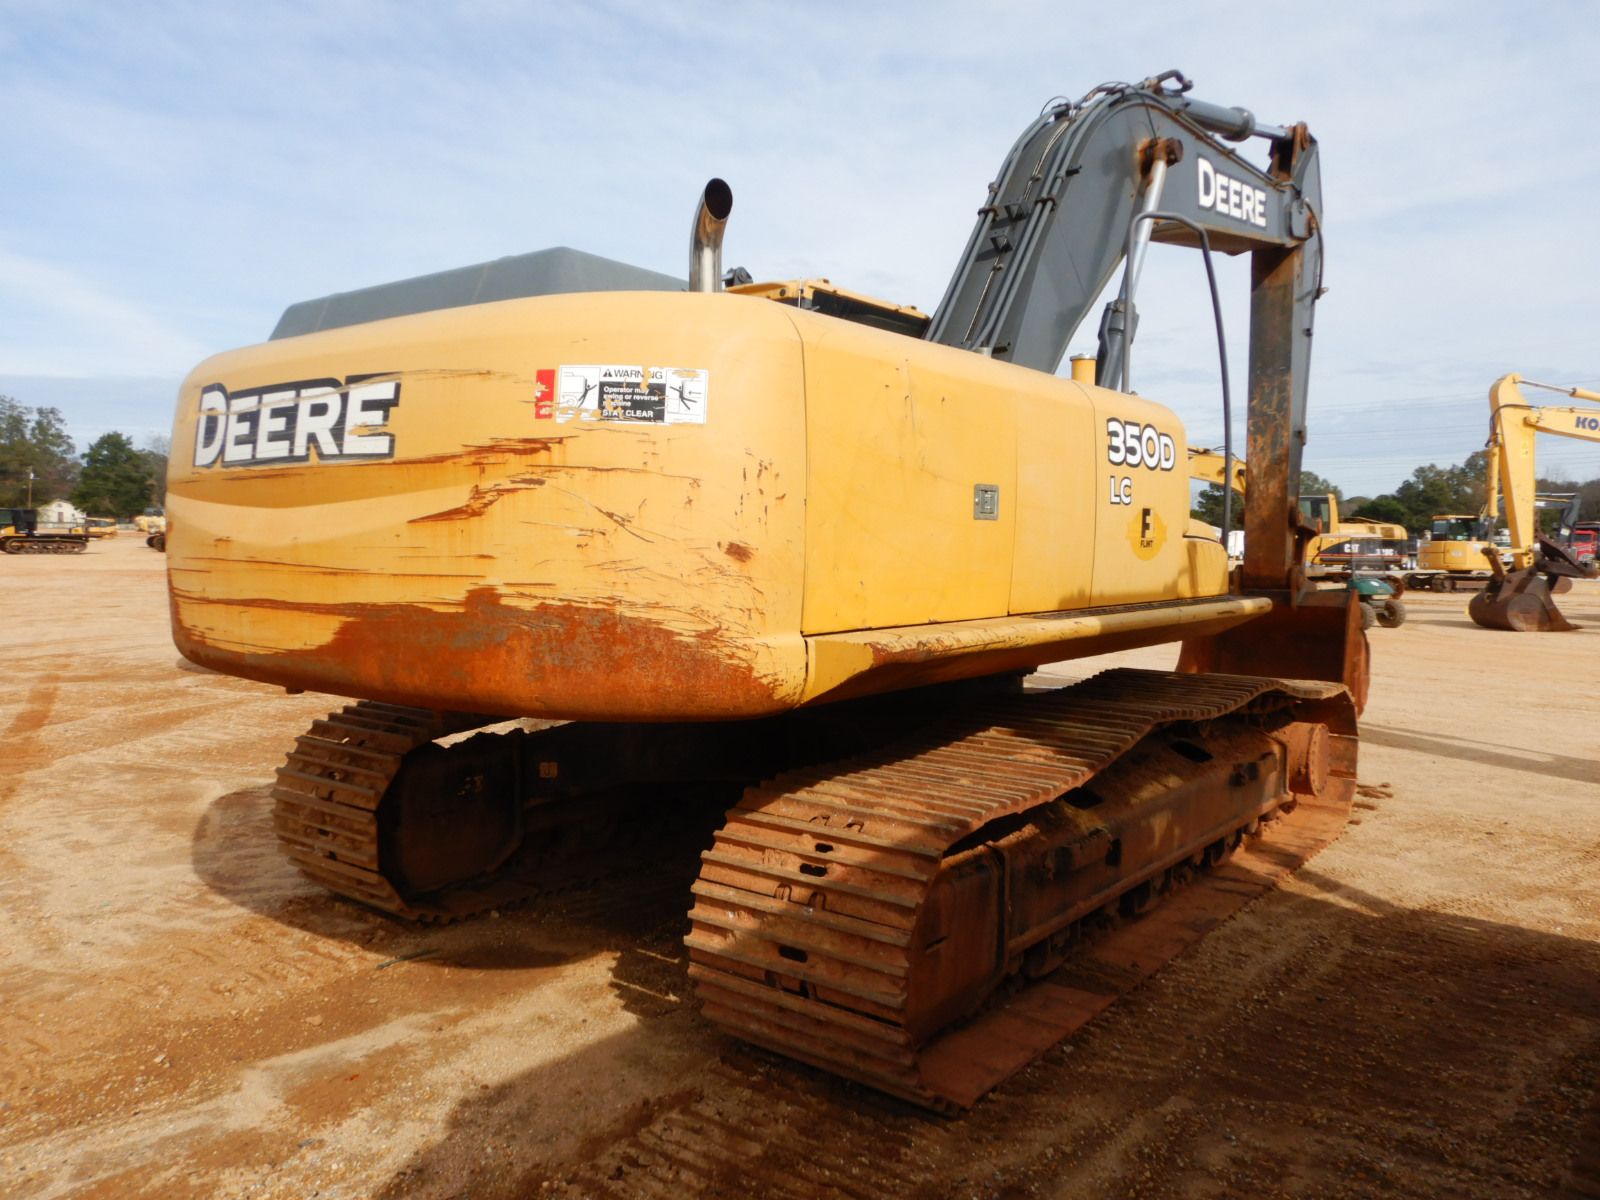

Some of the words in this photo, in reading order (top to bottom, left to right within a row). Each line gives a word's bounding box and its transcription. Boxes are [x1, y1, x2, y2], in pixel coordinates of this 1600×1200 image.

[1198, 156, 1267, 227] DEERE
[614, 369, 663, 379] WARNNG
[194, 373, 401, 467] DEERE
[625, 410, 654, 418] CLEAR
[1107, 417, 1176, 471] 350D
[1110, 475, 1132, 505] LC
